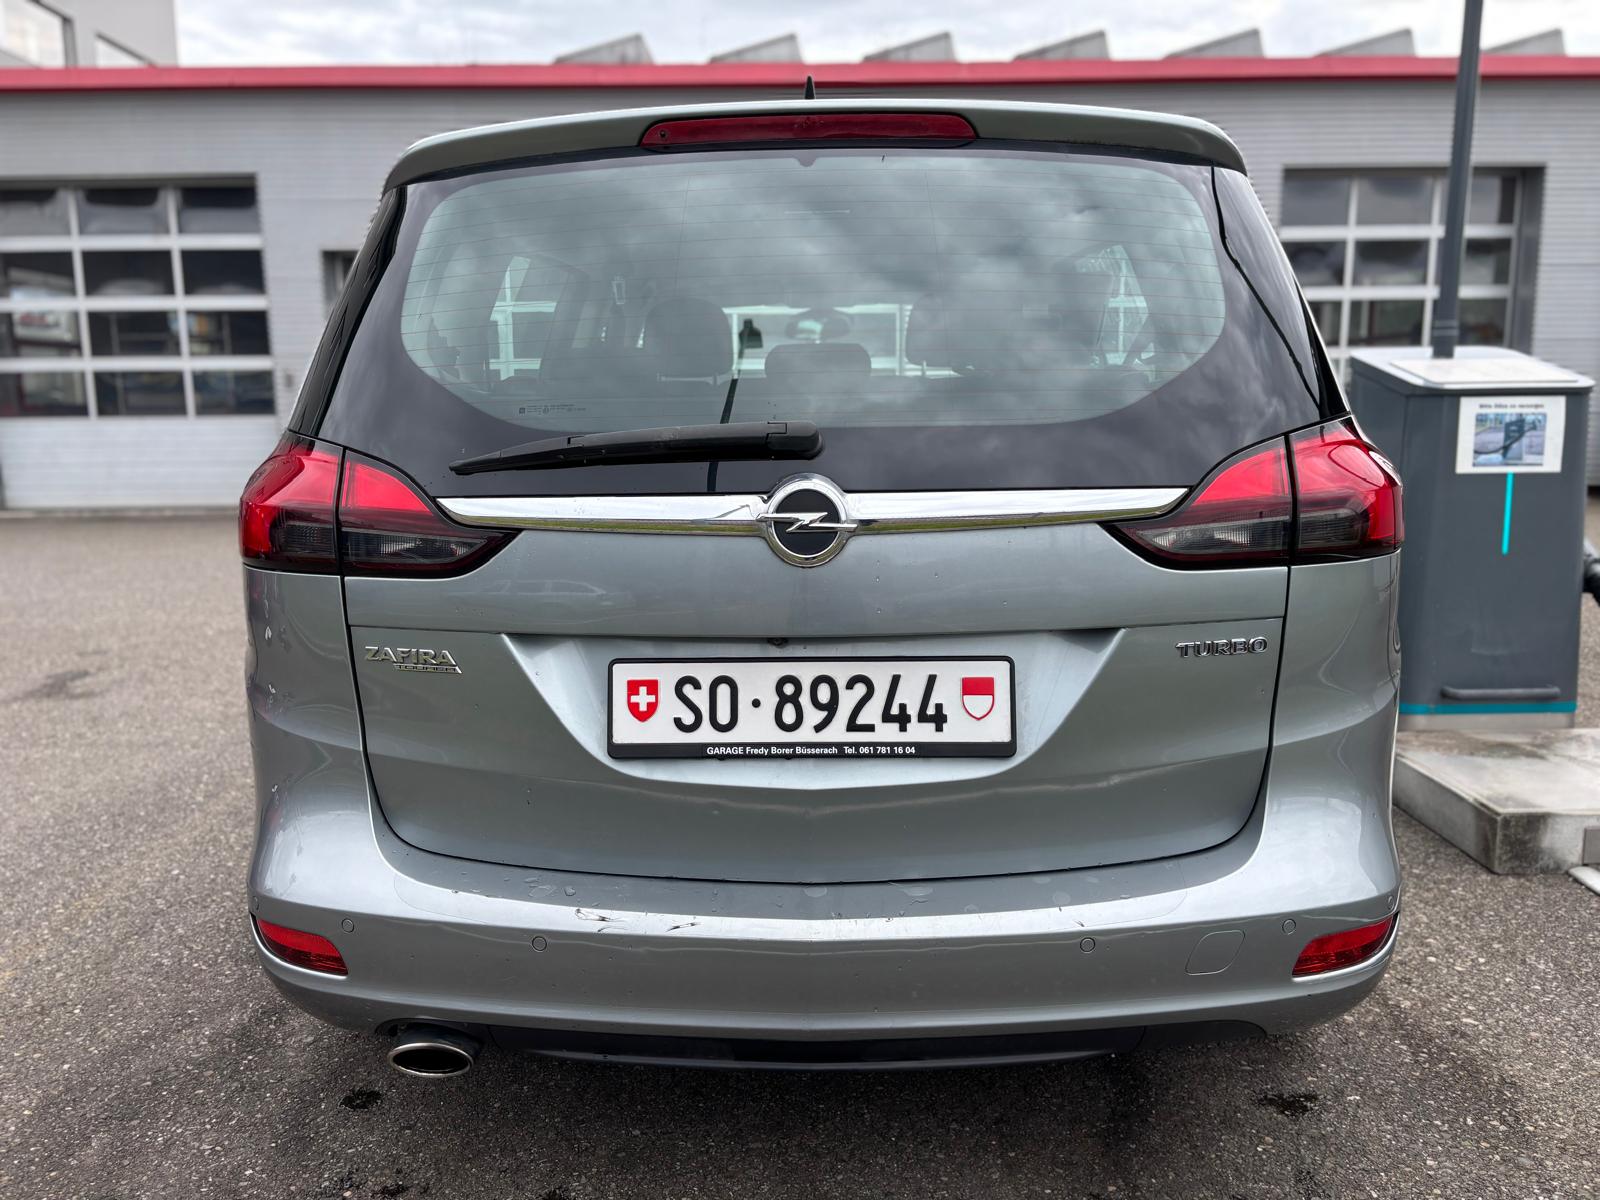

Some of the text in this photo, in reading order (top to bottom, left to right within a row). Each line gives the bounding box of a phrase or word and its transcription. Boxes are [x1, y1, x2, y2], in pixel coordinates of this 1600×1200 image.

[365, 646, 456, 665] ZAFIRA
[1175, 636, 1268, 657] TURBO
[774, 674, 948, 733] 89244
[706, 746, 916, 756] GARAGE Fredy Borer Büsserach Tel. 061 781 16 04
